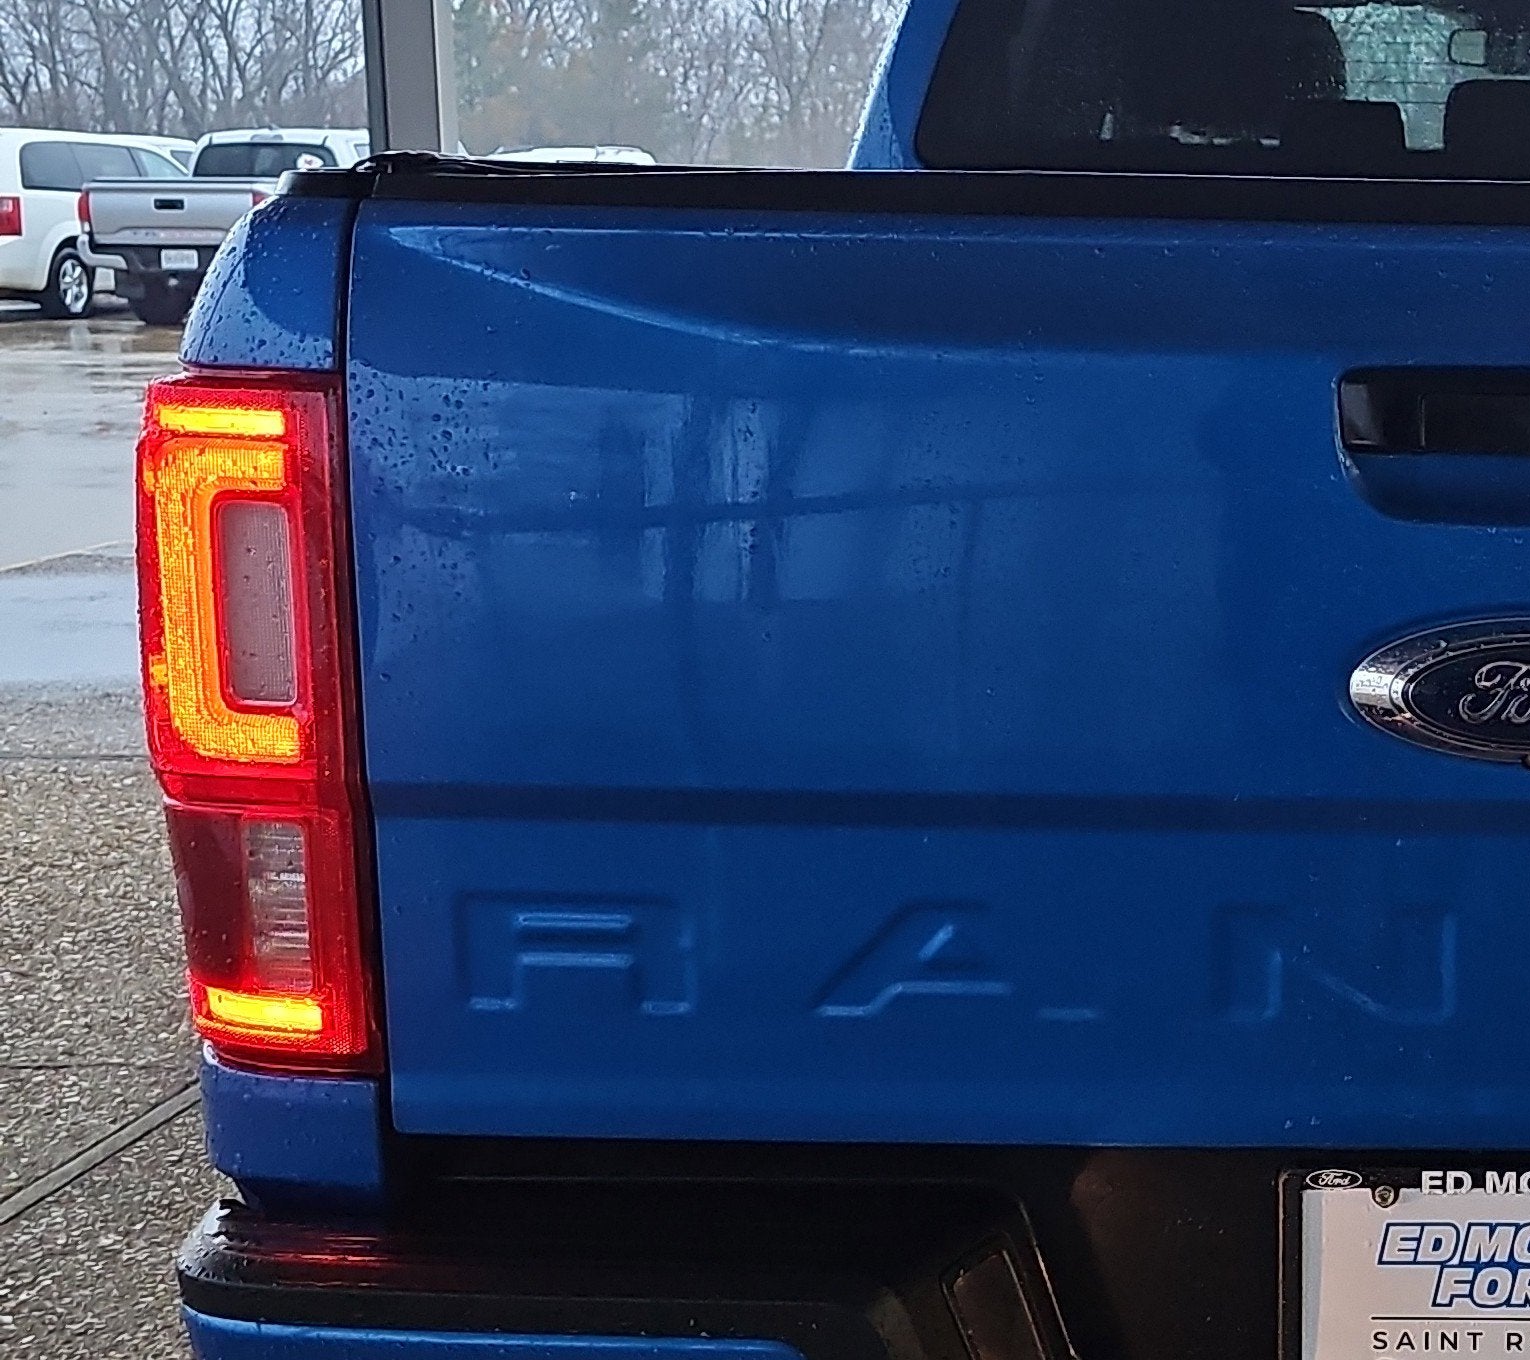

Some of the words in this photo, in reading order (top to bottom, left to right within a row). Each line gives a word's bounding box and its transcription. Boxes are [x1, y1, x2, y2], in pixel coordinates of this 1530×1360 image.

[1317, 1172, 1352, 1186] Ford
[1421, 1170, 1473, 1195] ED
[1377, 1222, 1459, 1265] ED
[1371, 1330, 1484, 1352] SAINT
